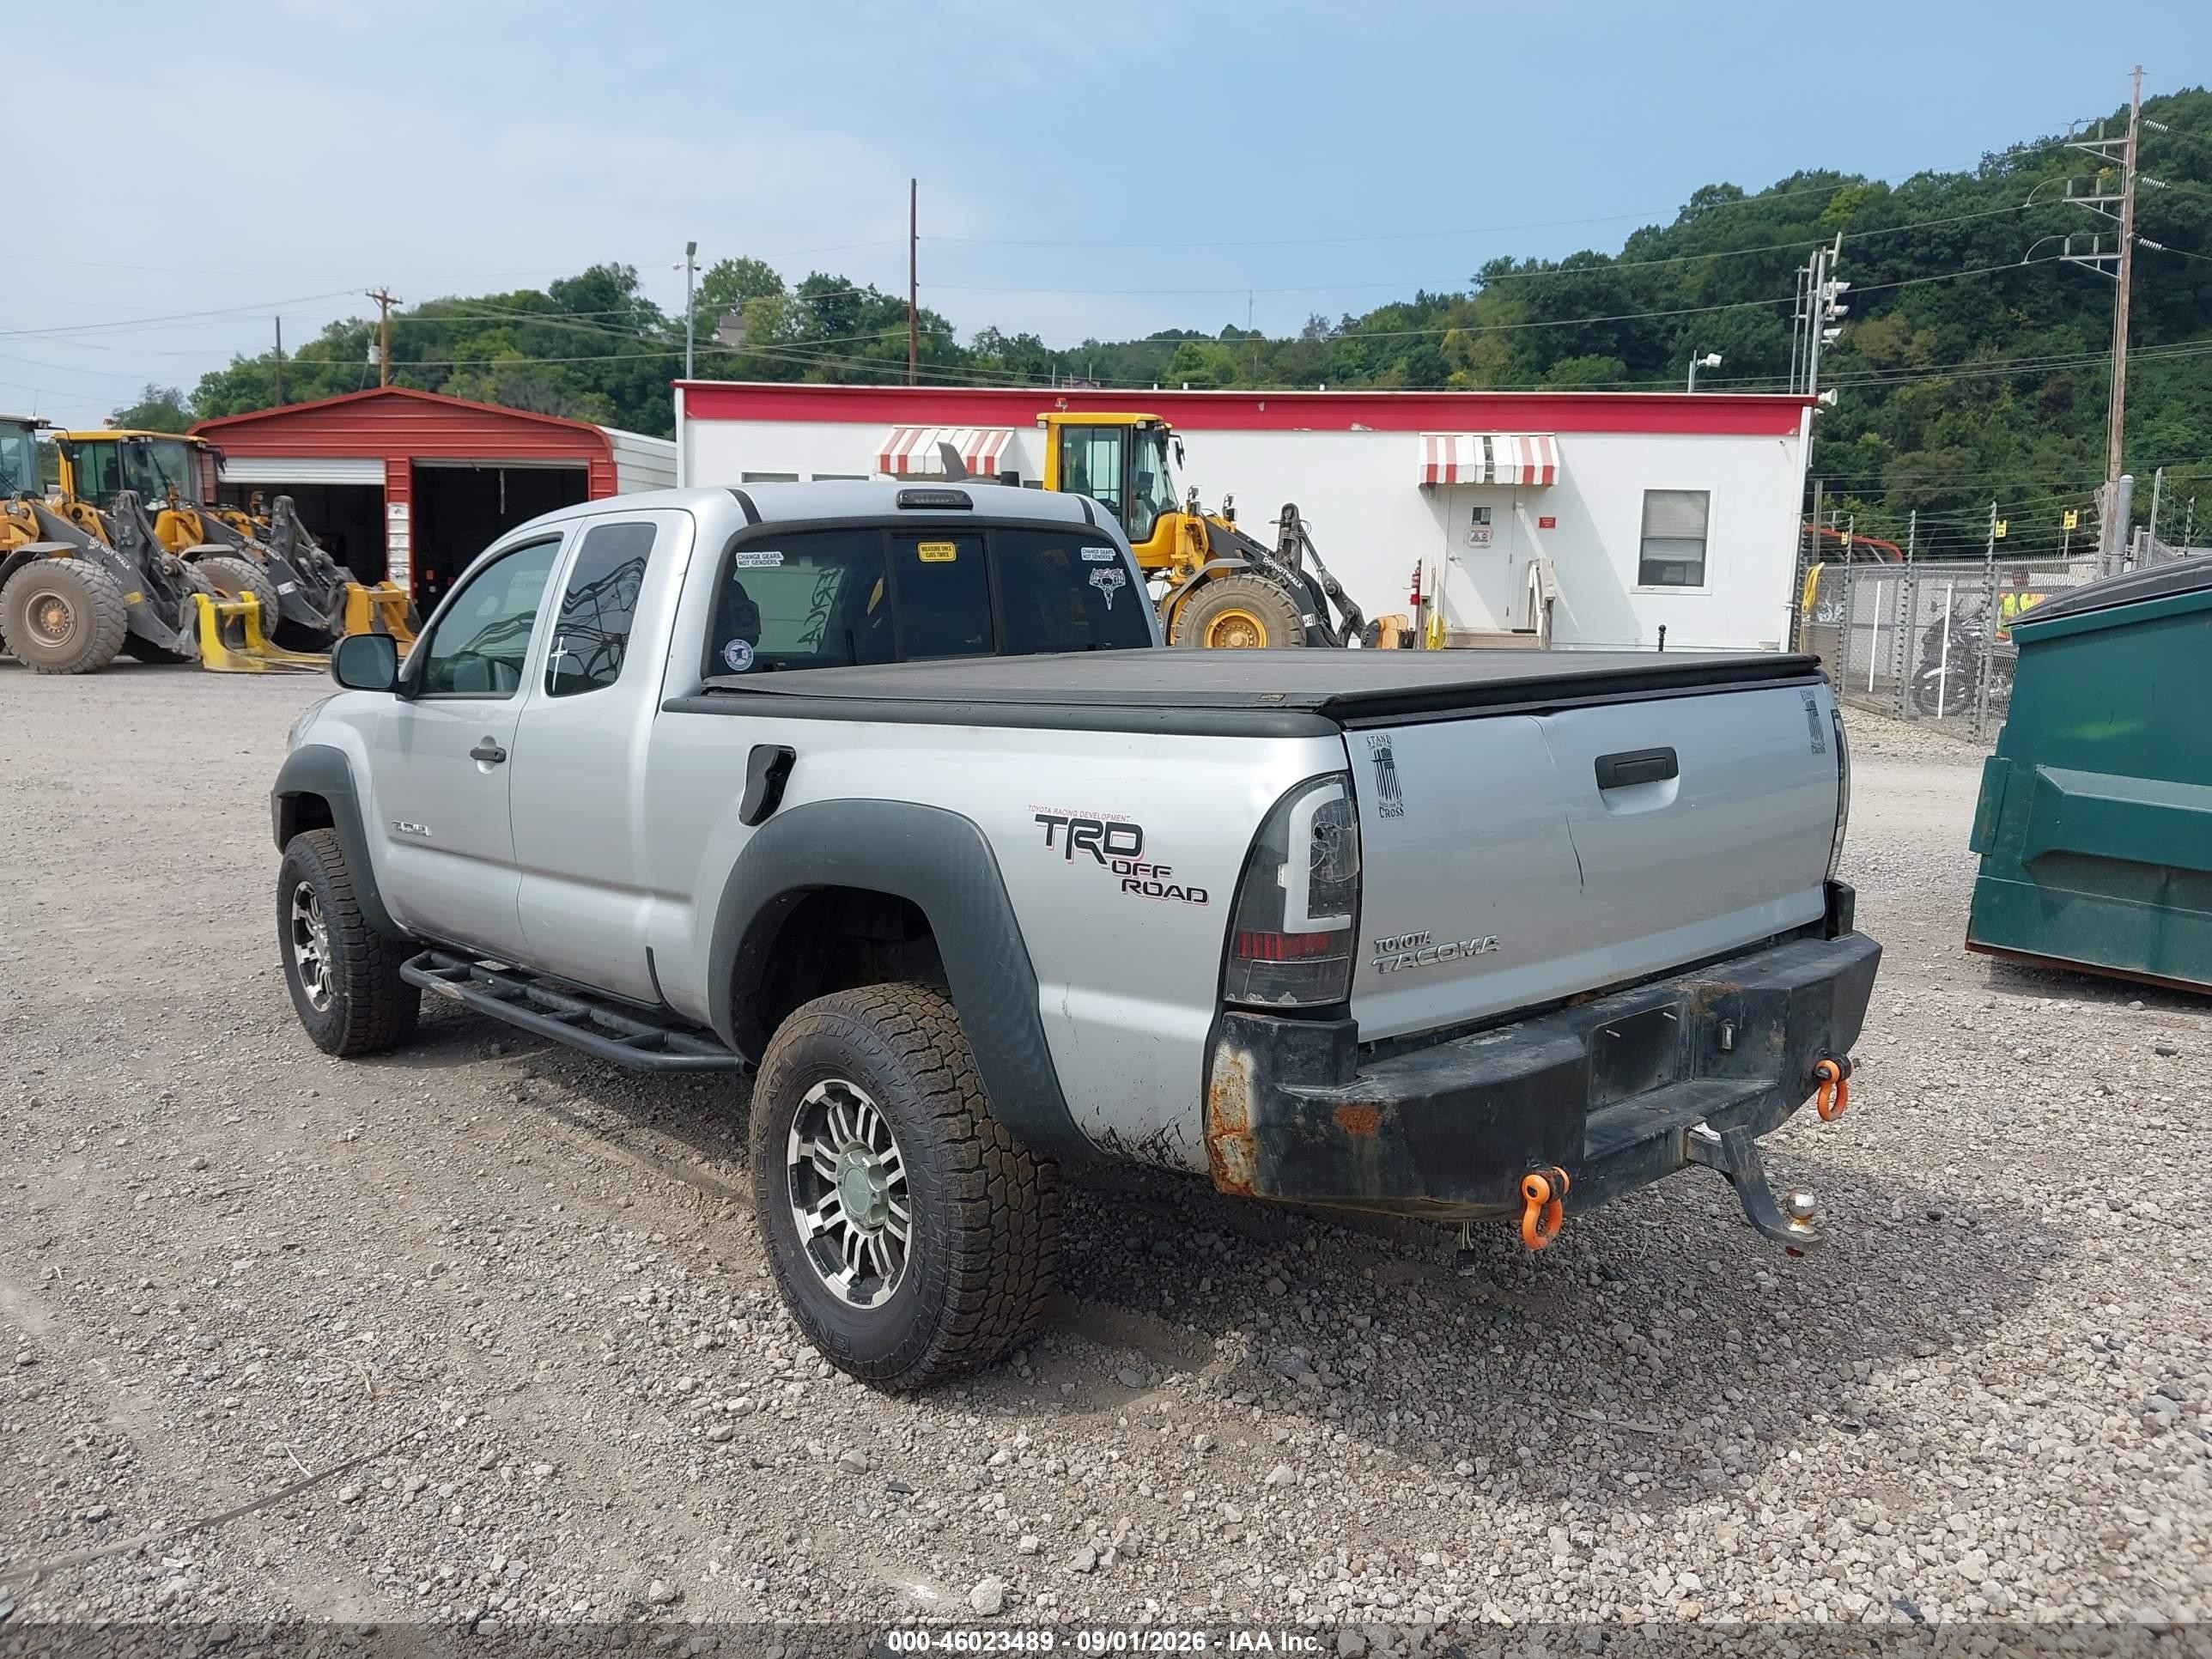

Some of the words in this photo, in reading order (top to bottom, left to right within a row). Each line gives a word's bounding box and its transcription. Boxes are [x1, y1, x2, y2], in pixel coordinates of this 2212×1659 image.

[89, 538, 100, 550] DO
[100, 542, 114, 558] NOT
[114, 552, 132, 571] WALK
[105, 570, 124, 586] MAST
[1366, 734, 1392, 745] STAND
[1029, 805, 1052, 814] TOYOTA
[1053, 808, 1079, 817] RACING
[1079, 811, 1132, 823] DEVELOPMENT
[1378, 805, 1405, 819] CROSS
[1034, 813, 1146, 867] TRD
[1111, 860, 1174, 880] OFF
[1121, 878, 1209, 905] ROAD
[1374, 930, 1432, 954] TOYOTA
[1371, 934, 1501, 974] TACOMA
